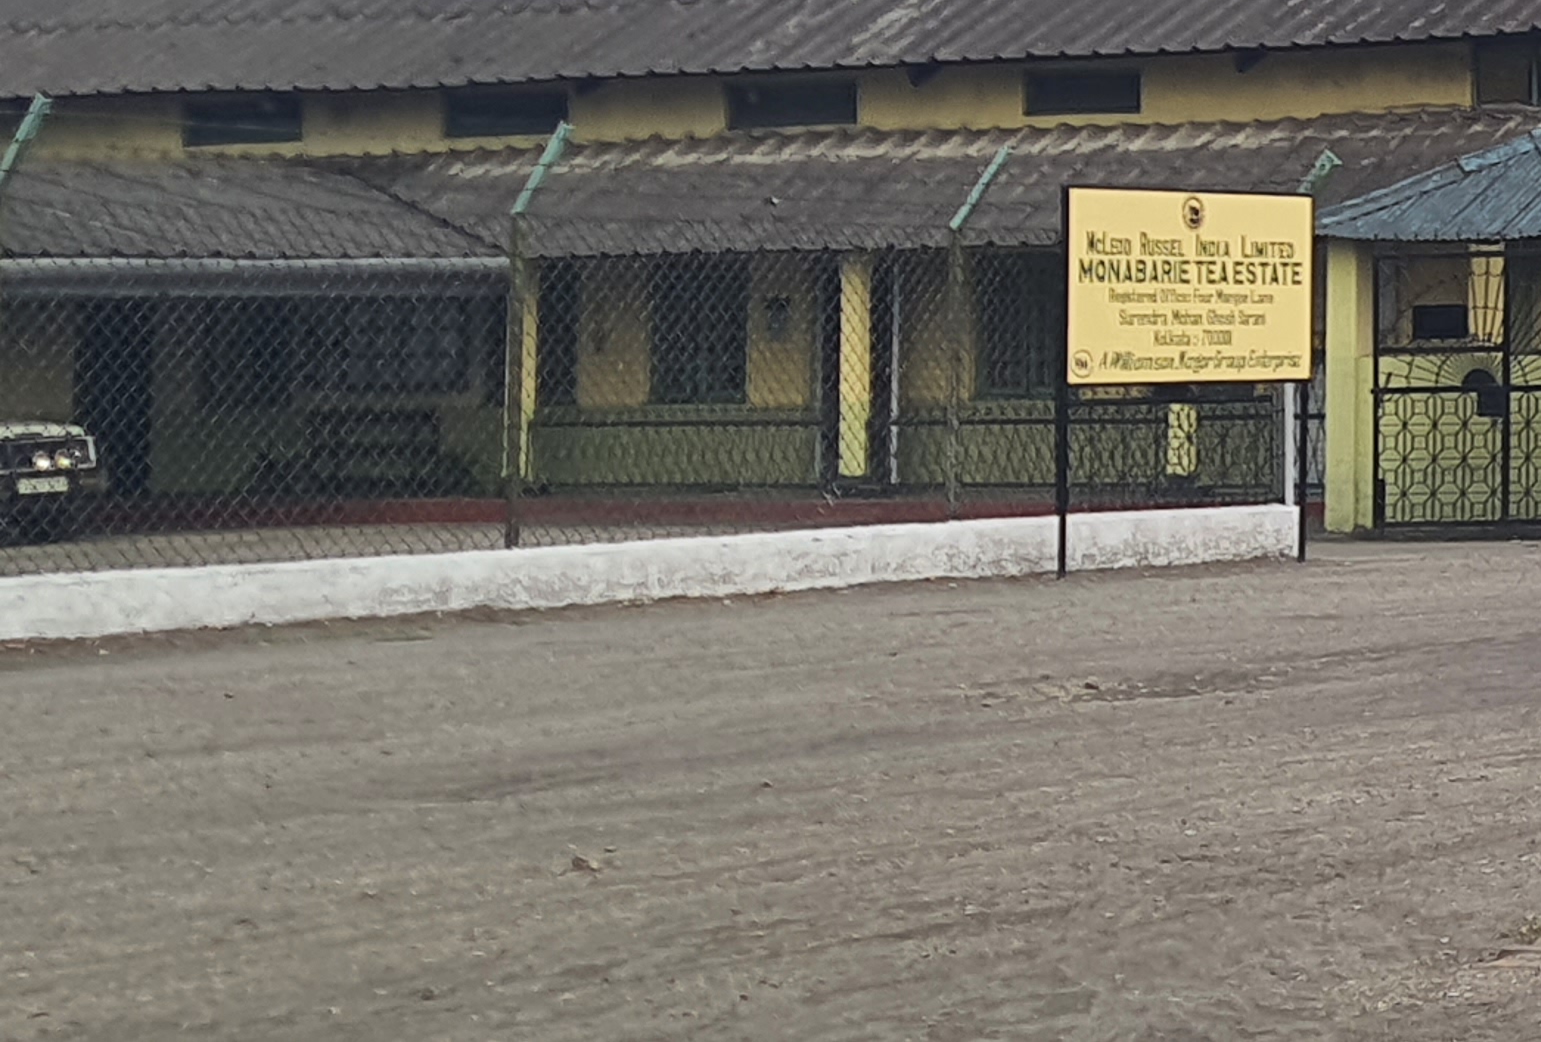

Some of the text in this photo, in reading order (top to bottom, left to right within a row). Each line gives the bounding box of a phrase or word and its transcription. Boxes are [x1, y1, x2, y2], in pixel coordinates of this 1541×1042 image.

[1139, 231, 1185, 257] RUSSEL
[1195, 233, 1231, 258] INDIA
[1240, 234, 1295, 259] LIMITED
[1078, 259, 1303, 286] MONABARIE TEA ESTATE
